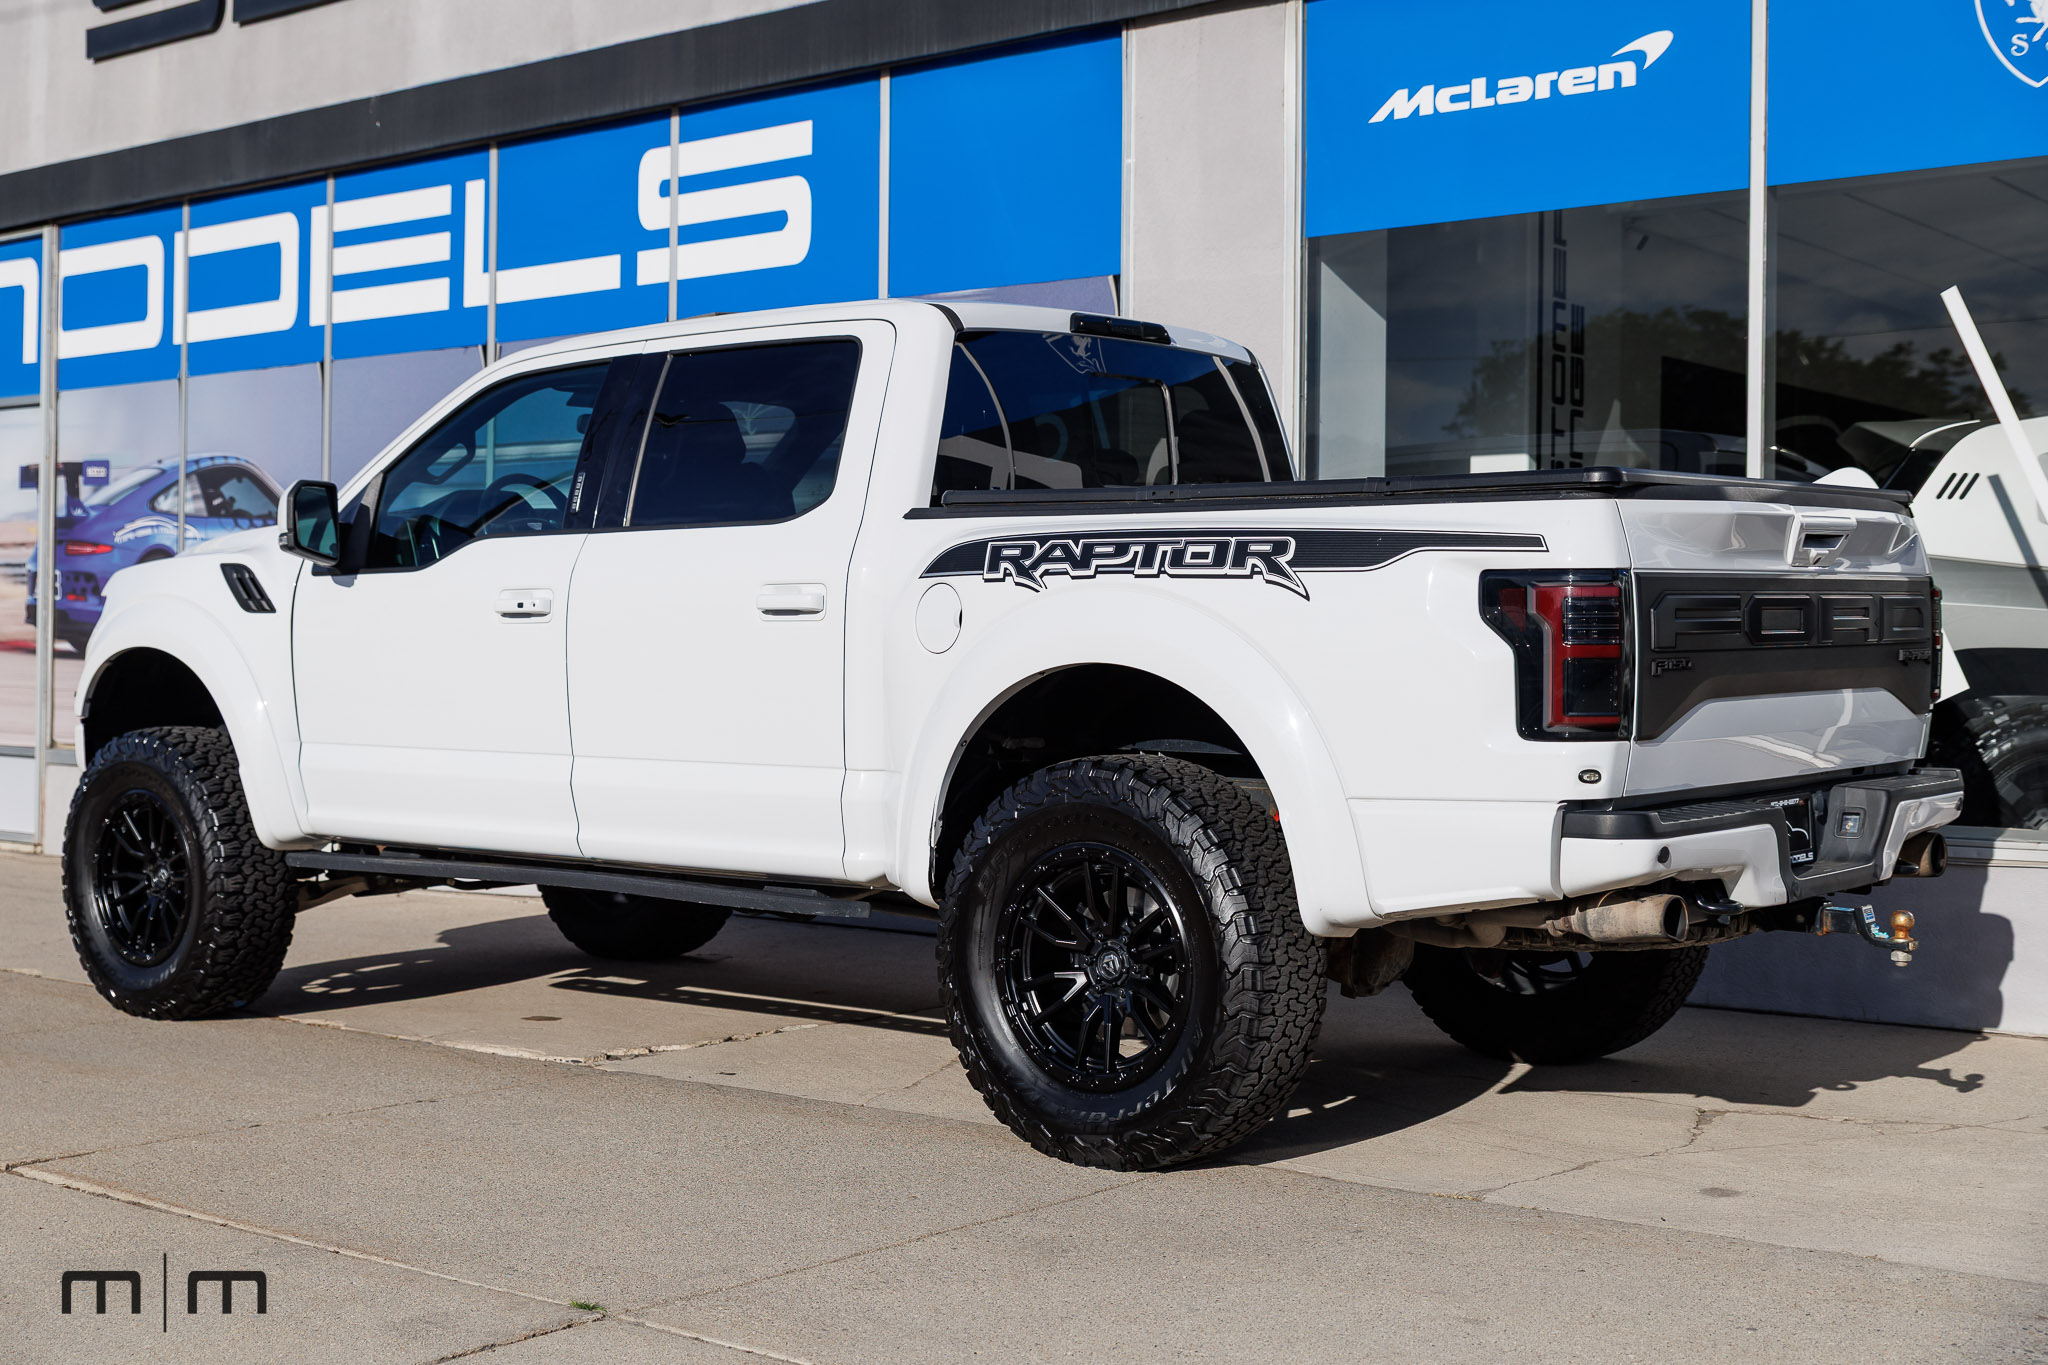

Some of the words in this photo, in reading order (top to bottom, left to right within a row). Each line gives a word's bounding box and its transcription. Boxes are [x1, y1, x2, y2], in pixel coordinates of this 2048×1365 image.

[1367, 60, 1638, 124] McLaren
[982, 536, 1310, 602] RAPTOR
[1650, 590, 1931, 651] FORD
